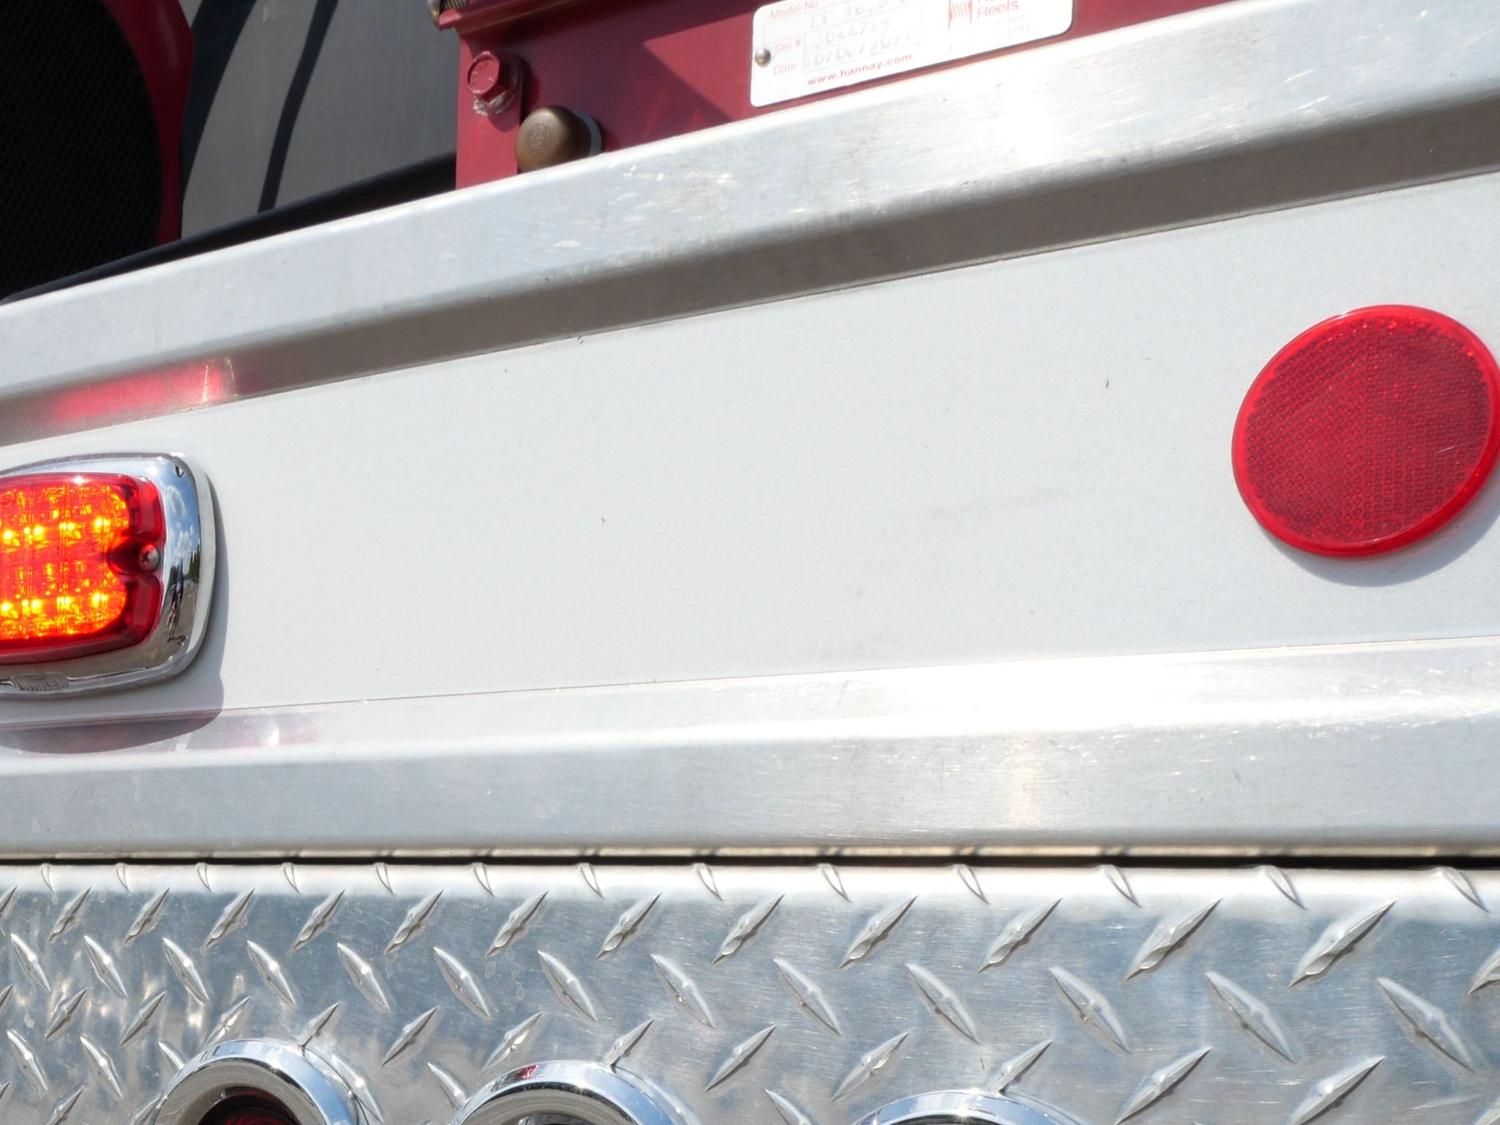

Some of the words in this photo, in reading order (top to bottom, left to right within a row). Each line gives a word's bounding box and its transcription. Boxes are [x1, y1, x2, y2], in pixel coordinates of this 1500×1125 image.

[770, 4, 801, 20] Model
[803, 0, 819, 10] No
[977, 0, 1020, 19] Reels
[810, 11, 831, 28] EF
[774, 42, 795, 55] Ser
[773, 61, 798, 76] Date
[807, 53, 913, 86] www.hannay.com
